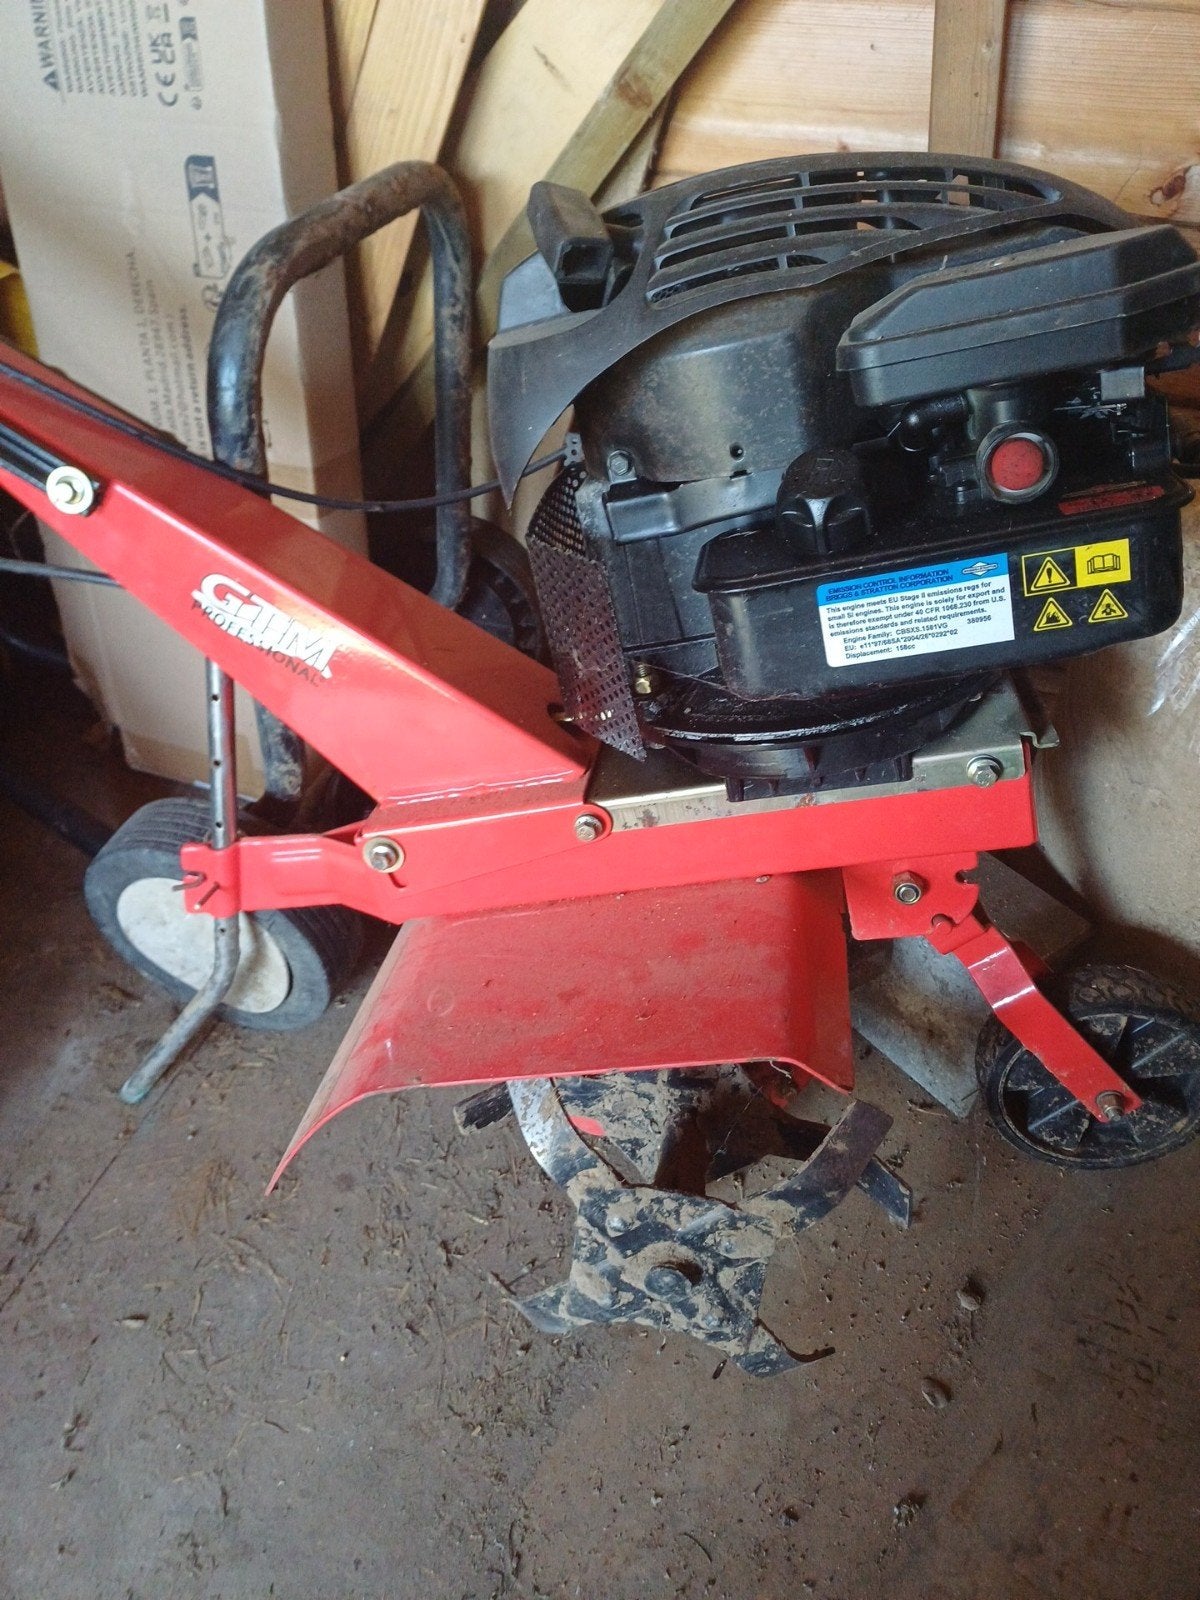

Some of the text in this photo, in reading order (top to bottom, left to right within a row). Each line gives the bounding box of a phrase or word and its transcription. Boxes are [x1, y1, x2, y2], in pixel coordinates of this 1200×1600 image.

[31, 0, 55, 68] WARNI
[178, 308, 193, 359] address
[186, 363, 199, 403] return
[826, 591, 852, 601] BRIGGS
[861, 584, 898, 595] STRATTON
[900, 574, 953, 589] CORPORATION
[828, 569, 949, 594] EMISSION CONTROL INFORMATION
[827, 613, 845, 621] small
[855, 607, 884, 618] engines.
[901, 600, 924, 610] engine
[933, 596, 954, 605] solely
[967, 590, 990, 600] export
[842, 602, 864, 612] engine
[866, 598, 886, 606] meets
[900, 593, 919, 602] Stage
[926, 586, 962, 597] emissions
[964, 583, 979, 592] regs
[829, 627, 863, 637] emissions
[864, 621, 898, 631] standards
[914, 615, 938, 623] related
[939, 607, 987, 621] requirements.
[836, 618, 866, 628] therefore
[867, 614, 892, 624] exempt
[942, 601, 971, 611] 1068.230
[973, 598, 989, 606] from
[843, 635, 866, 644] Engine
[867, 630, 892, 640] Family:
[845, 643, 915, 660] Displacement: 158cc
